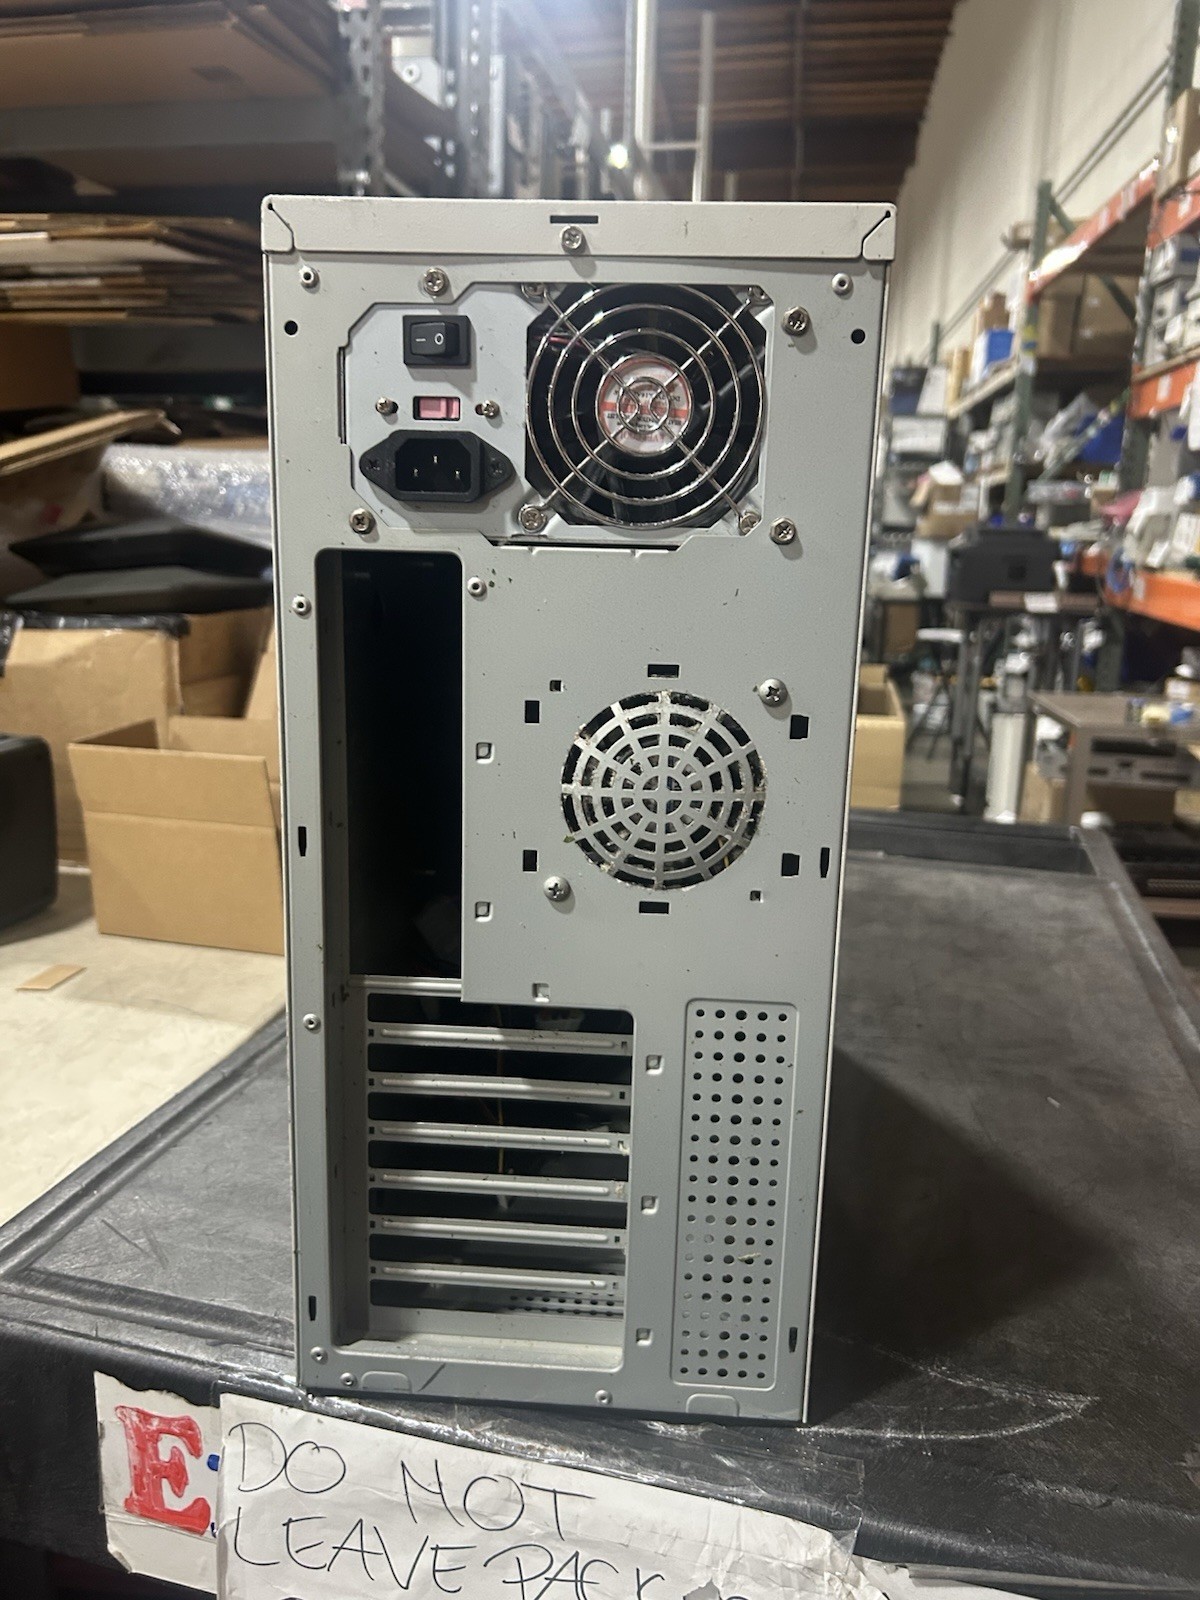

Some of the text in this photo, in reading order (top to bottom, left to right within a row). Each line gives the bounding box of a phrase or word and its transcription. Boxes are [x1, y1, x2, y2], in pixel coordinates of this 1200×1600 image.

[115, 1405, 211, 1536] E
[228, 1422, 597, 1542] DO NOT
[234, 1506, 477, 1593] LEAVE
